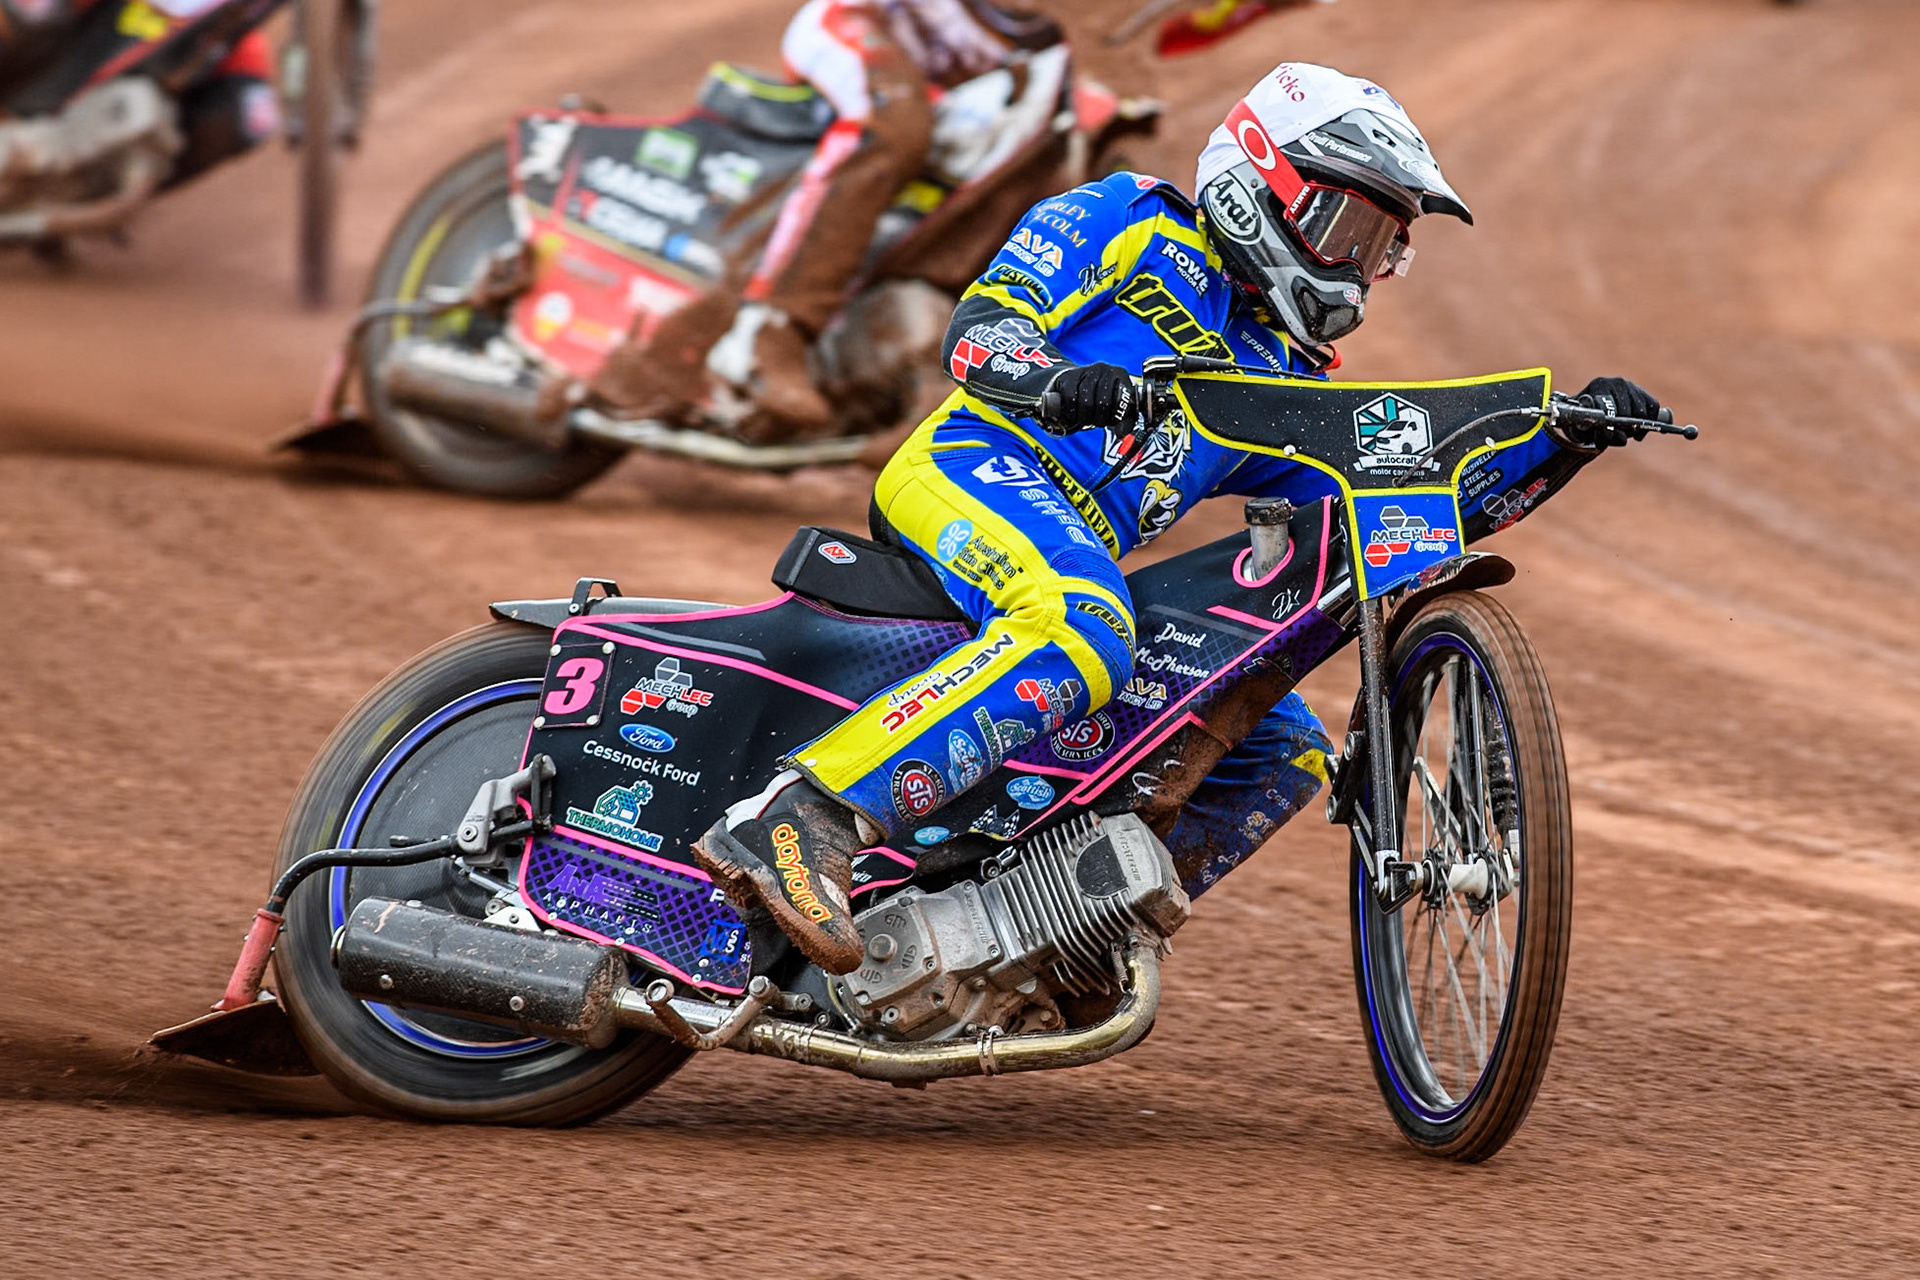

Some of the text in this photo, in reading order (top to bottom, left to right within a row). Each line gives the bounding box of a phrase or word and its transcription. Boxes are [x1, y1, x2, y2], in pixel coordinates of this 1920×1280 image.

[1325, 138, 1373, 163] Performance
[1211, 178, 1259, 231] Arai
[1161, 241, 1209, 293] ROWE
[1175, 266, 1198, 290] MOTOR
[991, 354, 1030, 380] Group
[1115, 387, 1131, 421] JUST1
[1602, 397, 1616, 431] JUS1
[1376, 457, 1418, 465] autocraft
[1463, 468, 1486, 488] STEEL
[1468, 470, 1501, 497] SUPPLIES
[1371, 528, 1456, 541] MECHLEC
[1414, 541, 1449, 554] Group
[968, 535, 1017, 579] Australian
[1154, 622, 1206, 648] David
[1136, 647, 1210, 679] McPherson
[544, 657, 604, 715] 3
[635, 676, 714, 707] MECHLEC
[880, 632, 1015, 733] MECHLEC
[888, 672, 941, 706] Group
[666, 698, 698, 718] Group
[629, 727, 665, 749] Ford
[583, 740, 700, 786] Cessnock Ford
[907, 778, 934, 810] STS
[1009, 782, 1052, 799] Scottish
[566, 807, 663, 852] THERMOHOME
[772, 823, 833, 924] daytona
